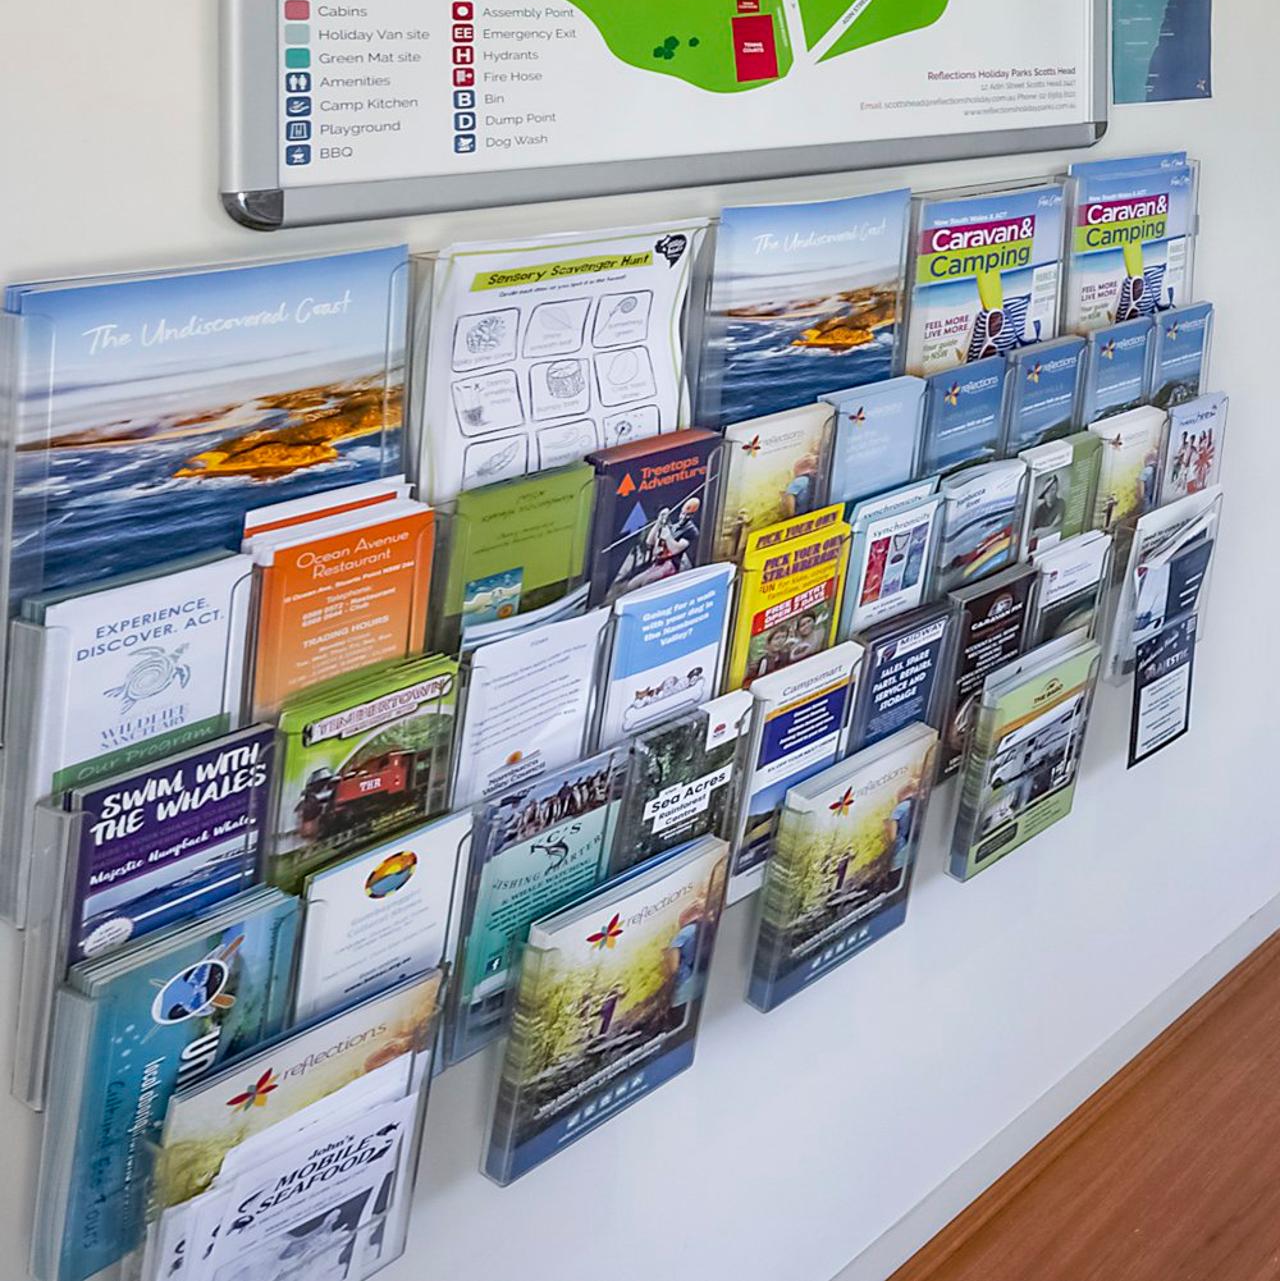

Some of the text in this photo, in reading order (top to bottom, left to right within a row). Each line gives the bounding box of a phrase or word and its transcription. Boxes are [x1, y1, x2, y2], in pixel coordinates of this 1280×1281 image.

[317, 5, 368, 17] Cabins
[482, 7, 574, 20] Assembly Point
[318, 29, 431, 42] Holiday Van site
[455, 28, 577, 41] EE Emergency Exit
[318, 51, 422, 64] Green Mat site
[456, 48, 539, 63] H Hydrants
[319, 74, 391, 87] Amenities
[483, 71, 543, 83] Fire Hose
[927, 67, 1076, 81] Reflections Holiday Parks Scotts Head
[320, 97, 418, 112] Camp Kitchen
[458, 91, 505, 107] B Bin
[319, 120, 401, 137] Playground
[459, 113, 557, 129] D Dump Point
[319, 146, 354, 160] BBQ
[485, 134, 548, 149] Dog Wash
[1086, 219, 1166, 247] Camping
[487, 254, 649, 286] Sensory Scavenger Hunt
[930, 246, 1031, 277] Camping
[1081, 280, 1118, 294] FEEL MORE
[82, 289, 352, 355] The Undiscovered Coast
[924, 314, 970, 331] FEEL MORE
[924, 329, 942, 339] LIVE
[641, 455, 699, 479] Treetops
[296, 532, 409, 569] Ocean Avenue
[312, 549, 392, 580] Restaurant
[96, 597, 210, 640] EXPERIENCE.
[76, 609, 225, 662] DISCOVER. ACT.
[318, 678, 447, 736] TIMBERTOWN
[77, 726, 214, 781] Our Program
[101, 742, 260, 820] SWIM WITH
[651, 772, 726, 814] Sea Acres
[89, 763, 267, 847] THE WHALES
[658, 793, 706, 820] Rainforest
[148, 830, 210, 863] Humpback
[626, 883, 695, 928] reflections
[283, 1023, 387, 1080] reflections
[308, 1134, 355, 1161] John's
[274, 1134, 376, 1193] MOBILE
[256, 1146, 378, 1215] SEAFOOD
